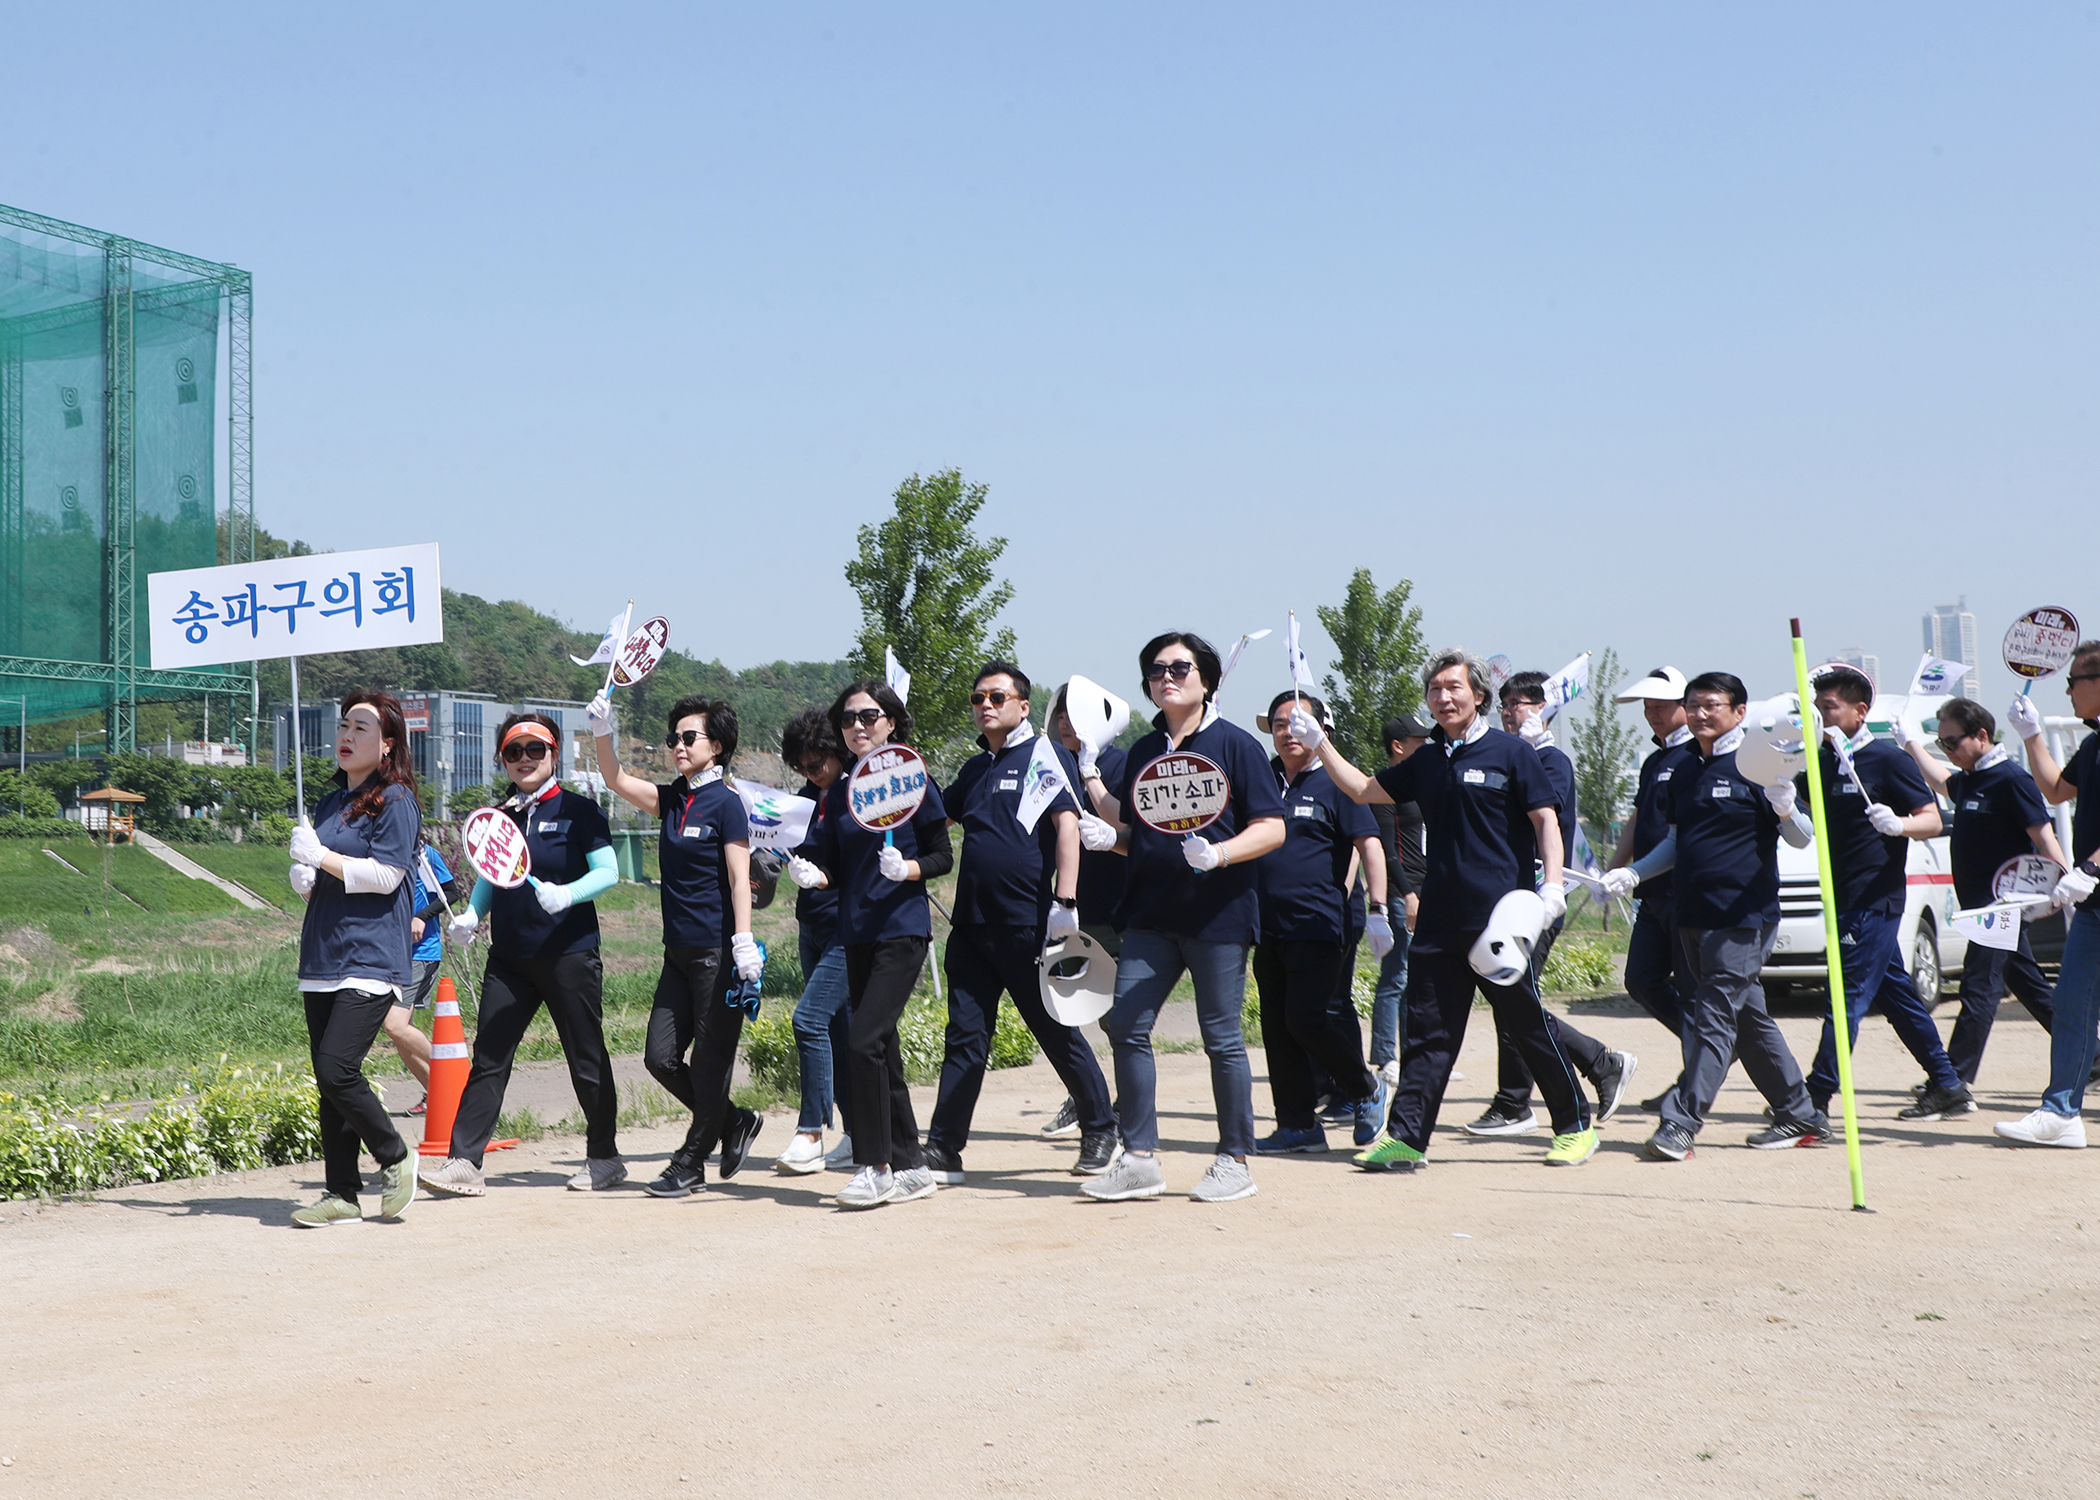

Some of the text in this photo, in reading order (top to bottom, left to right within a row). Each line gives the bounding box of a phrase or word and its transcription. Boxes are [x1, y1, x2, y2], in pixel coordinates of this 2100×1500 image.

[172, 566, 414, 645] 송파구의회
[1138, 778, 1225, 811] 최강 송파
